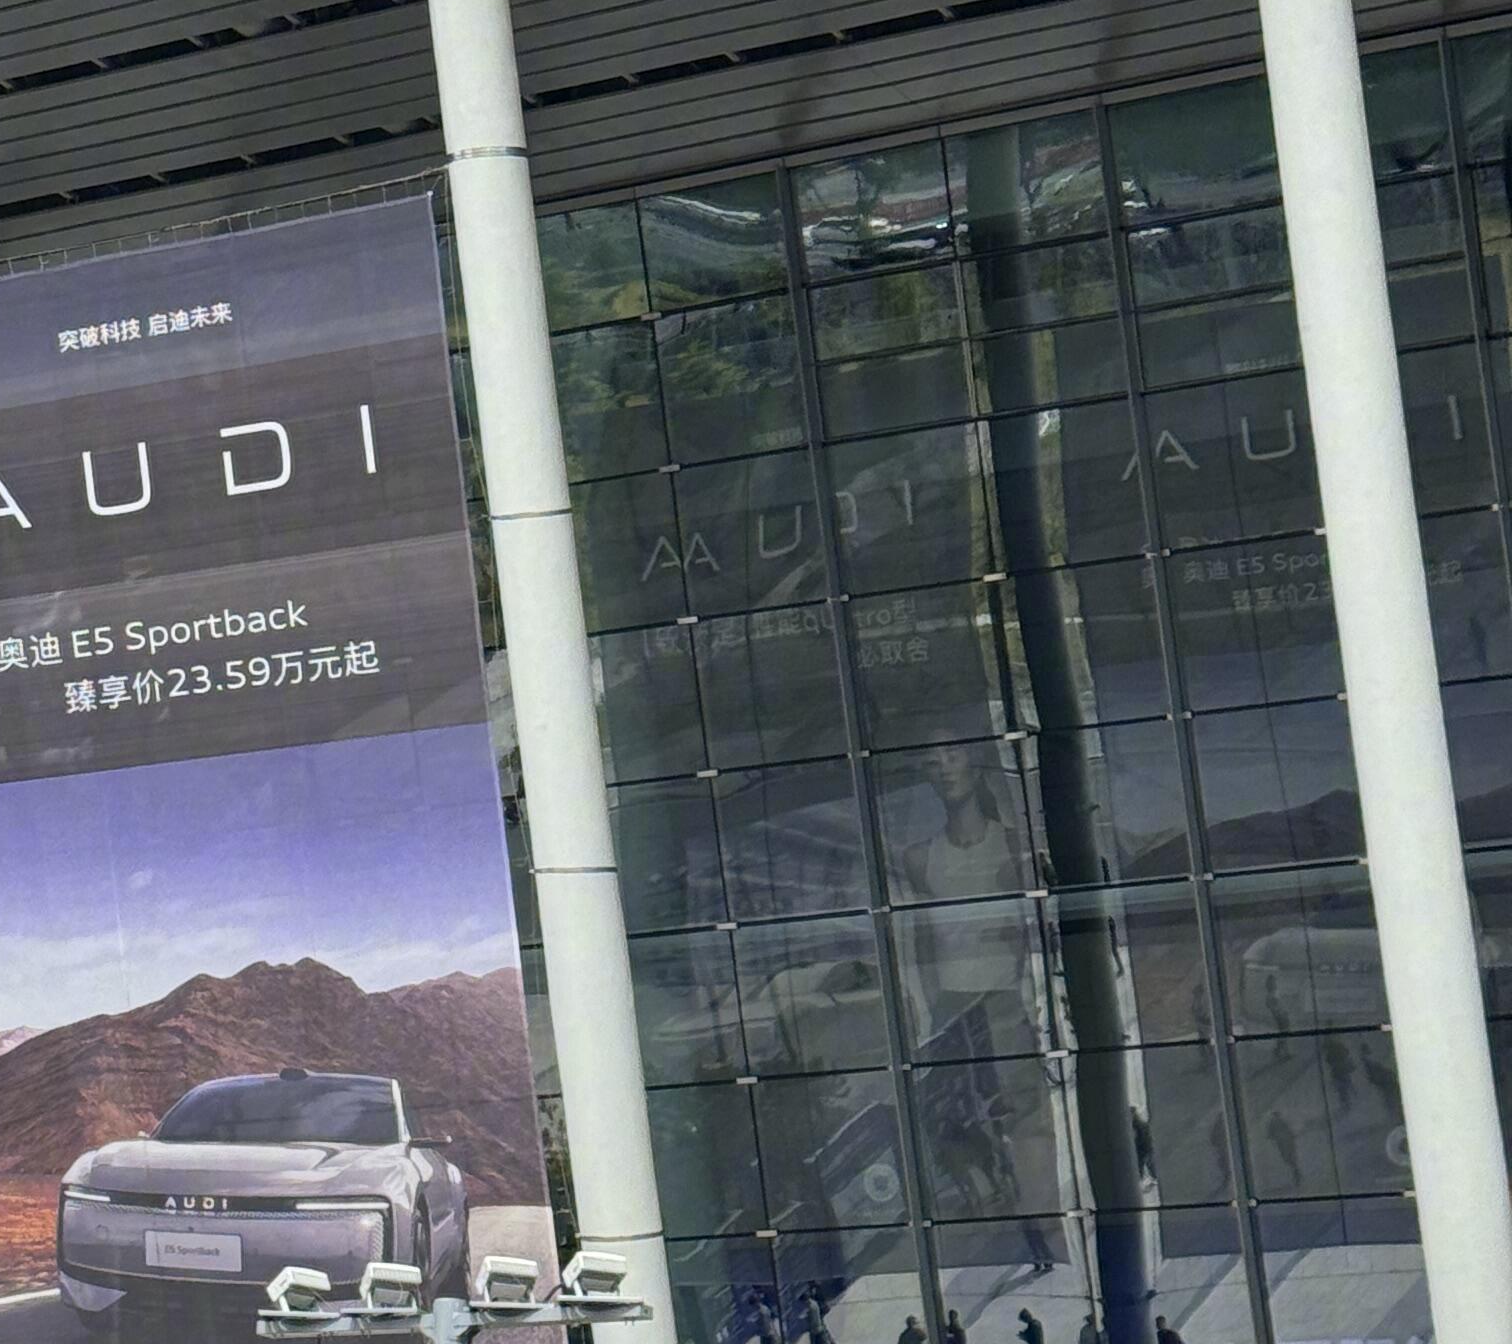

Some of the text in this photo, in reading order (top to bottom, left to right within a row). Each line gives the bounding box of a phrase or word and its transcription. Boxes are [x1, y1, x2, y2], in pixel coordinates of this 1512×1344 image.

[58, 302, 233, 353] 突破科技 启迪未来
[71, 627, 113, 660] E5
[125, 600, 308, 654] Sportback
[63, 640, 380, 714] 臻享价23.59万元起
[165, 1196, 228, 1210] AUDI
